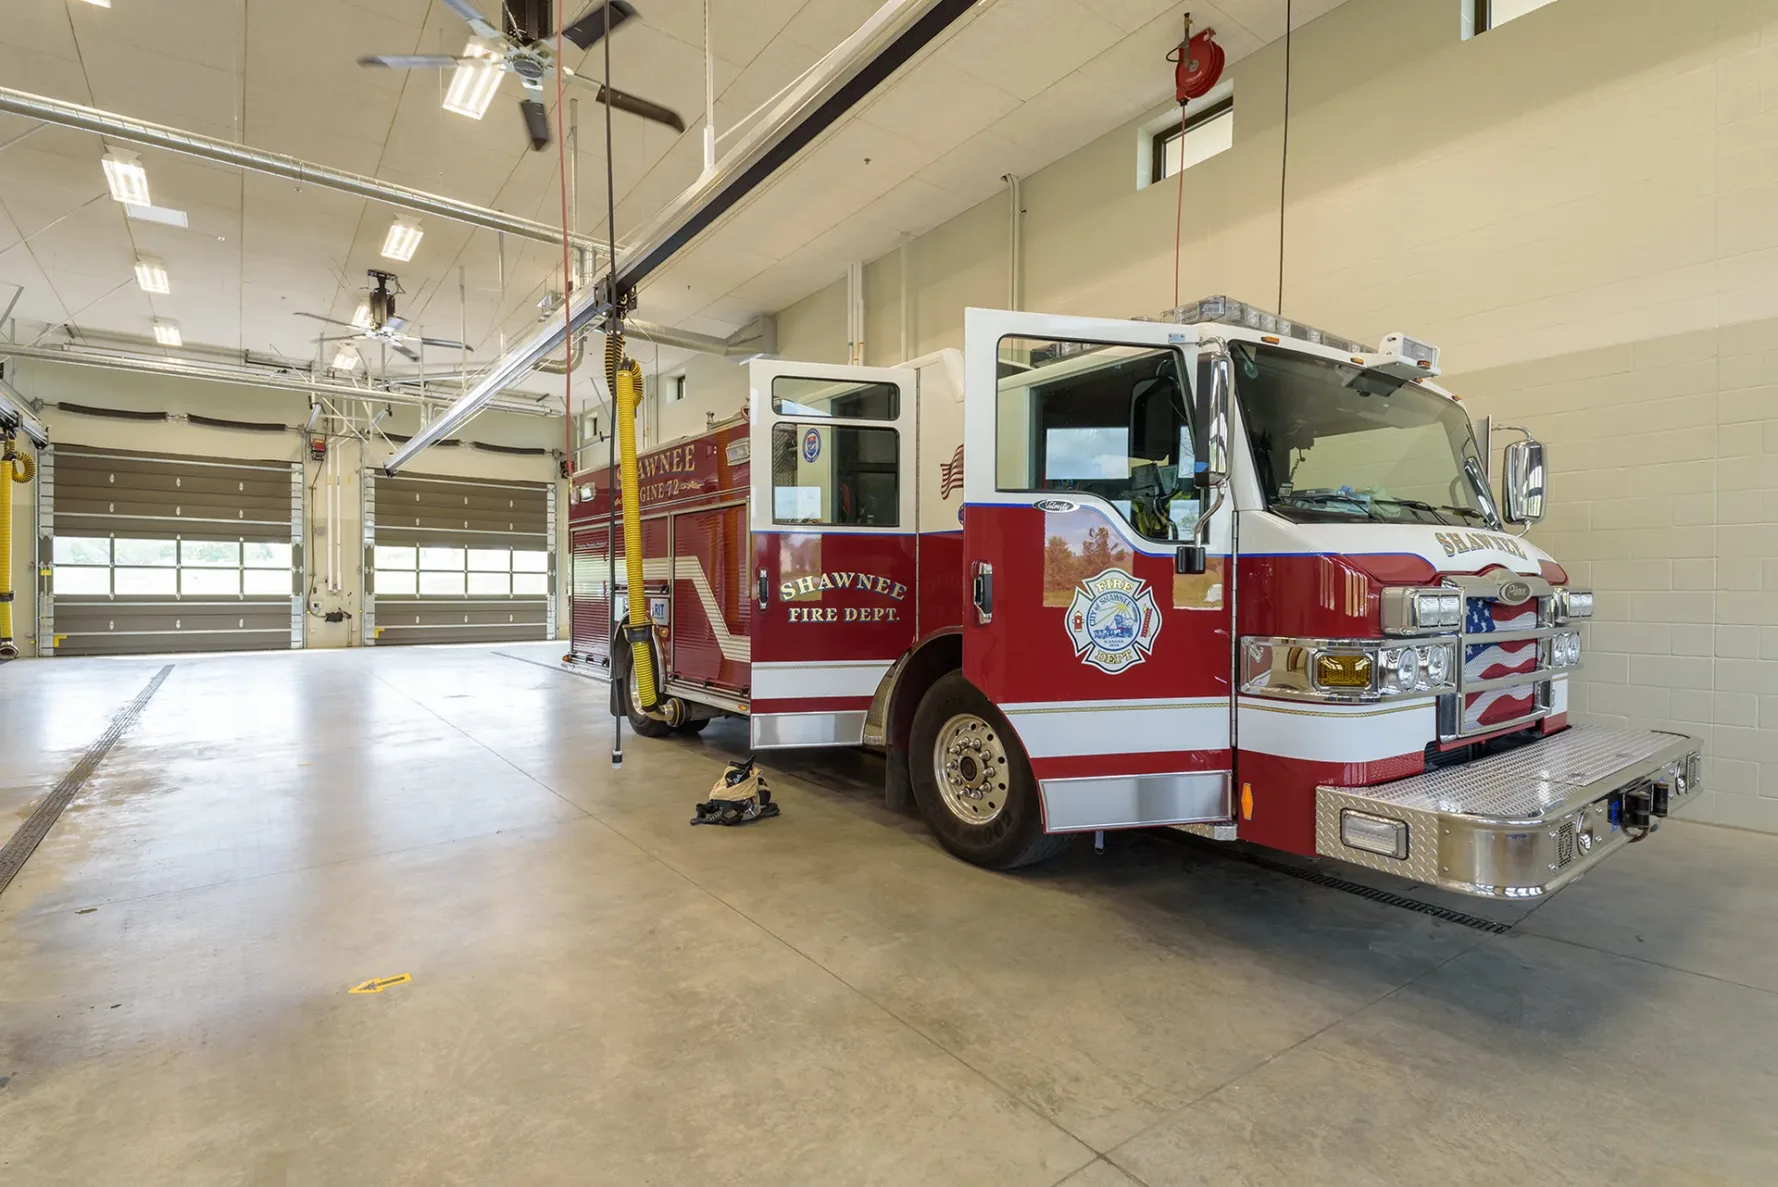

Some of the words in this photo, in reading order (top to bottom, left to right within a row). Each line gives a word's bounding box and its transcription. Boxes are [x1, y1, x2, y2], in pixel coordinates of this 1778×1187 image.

[616, 444, 696, 490] SAWNEE
[1434, 532, 1528, 560] SHAWNEE
[780, 572, 908, 602] SHAWNEE
[1095, 579, 1133, 593] FIRE
[788, 607, 838, 622] FIRE
[843, 607, 900, 622] DEPT.
[1089, 610, 1098, 627] CITY
[1096, 650, 1132, 664] DEPT
